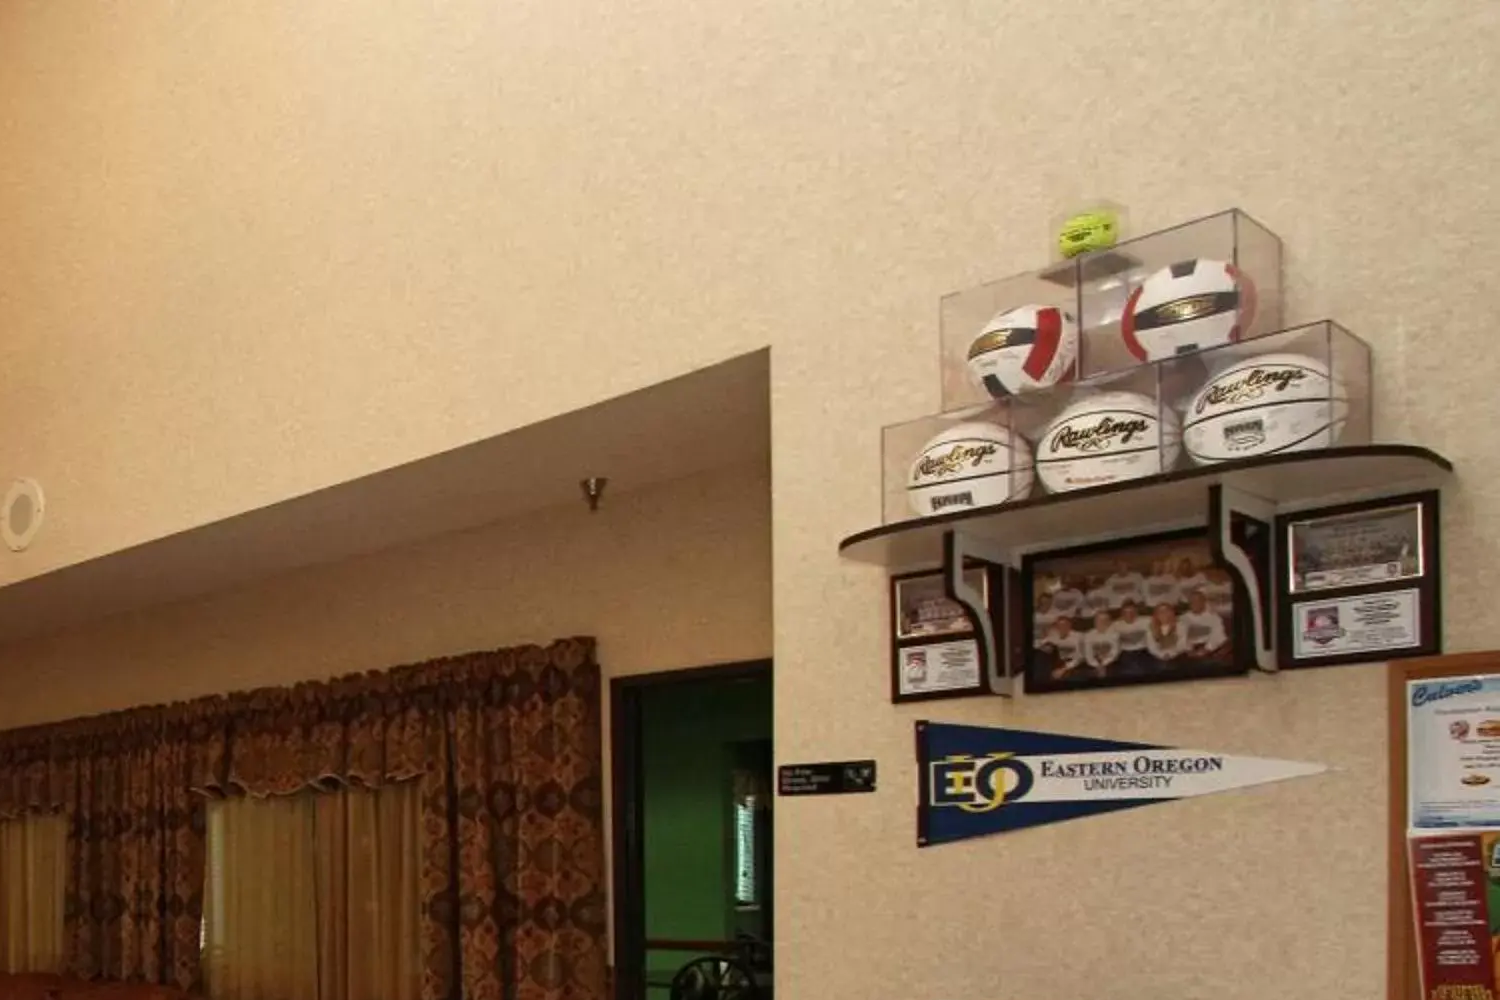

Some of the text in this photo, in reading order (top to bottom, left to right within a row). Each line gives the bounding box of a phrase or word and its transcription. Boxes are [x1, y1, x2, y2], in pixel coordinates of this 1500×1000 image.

[1195, 368, 1308, 415] Rawlings
[1050, 416, 1150, 453] Rawlings
[913, 444, 997, 481] Rawlings
[1040, 755, 1224, 778] EASTERN OREGON
[1083, 774, 1173, 791] UNIVERSITY
